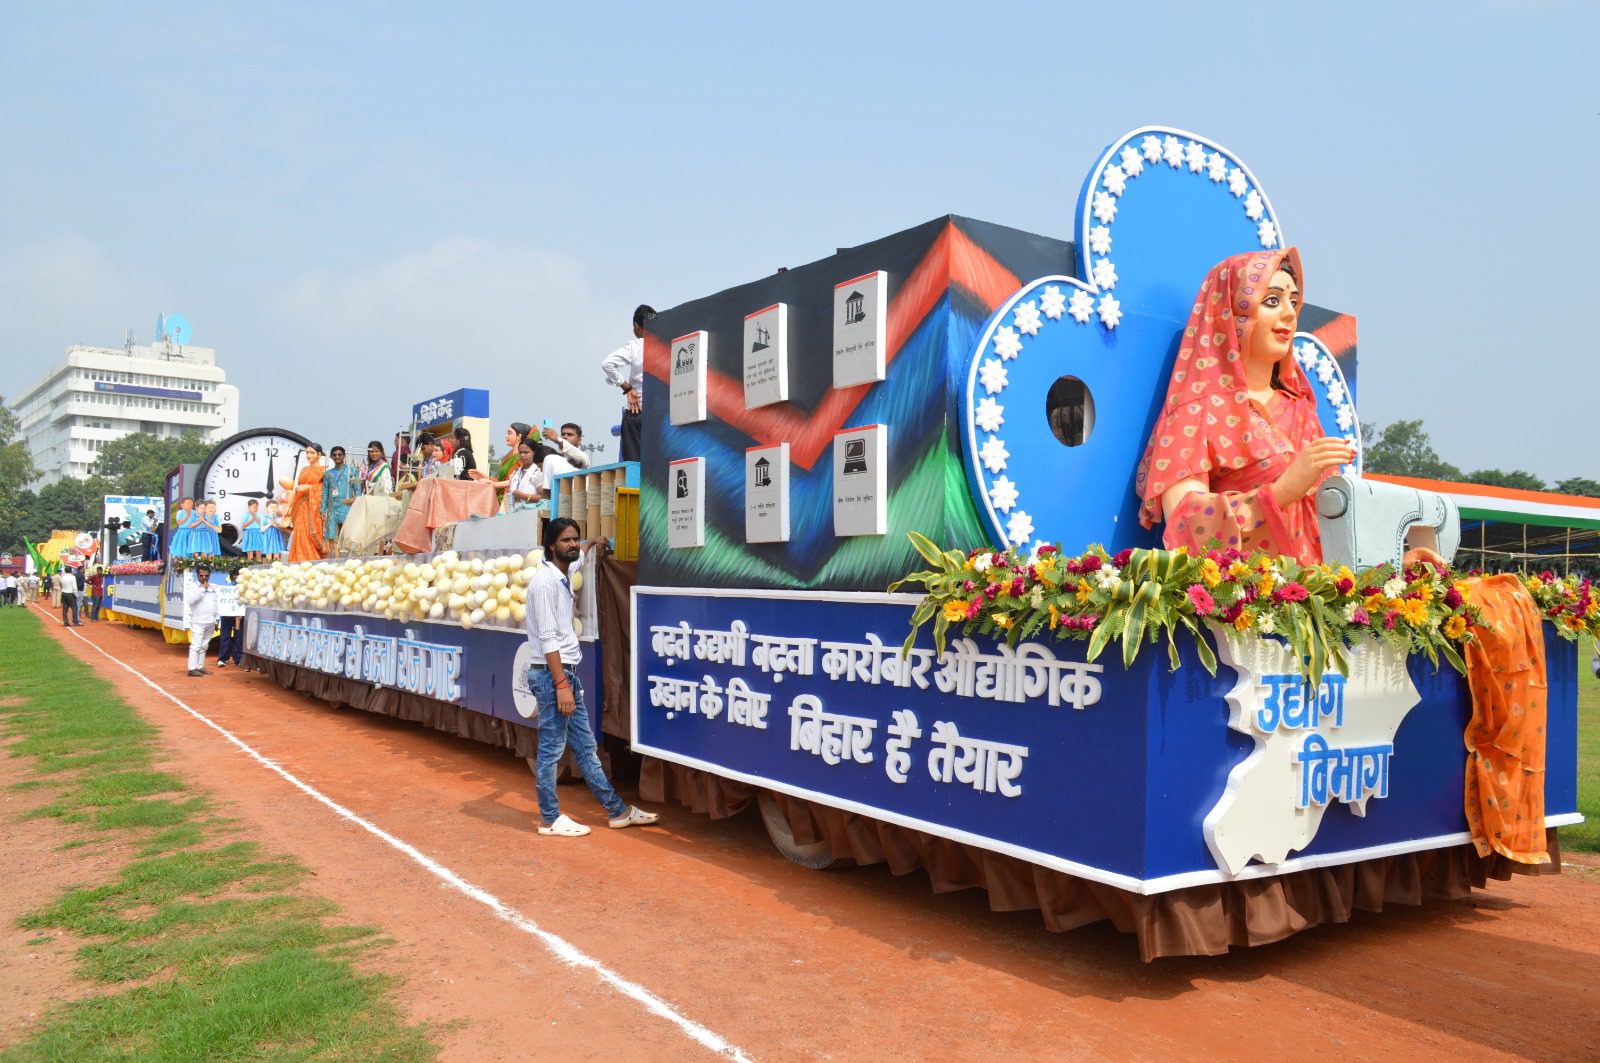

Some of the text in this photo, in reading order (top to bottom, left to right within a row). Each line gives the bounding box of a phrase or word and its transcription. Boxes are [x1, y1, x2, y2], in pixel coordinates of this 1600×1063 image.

[243, 452, 256, 462] 11
[265, 448, 279, 458] 12
[225, 468, 239, 478] 10
[219, 490, 226, 498] 9
[224, 512, 231, 521] 8
[649, 619, 1104, 710] बढ़ते उद्यमी बढ़ता कारोबार औद्योगिक
[648, 674, 1029, 798] उड़ान के लिए बिहार है तैयार
[1296, 733, 1394, 810] विभाग
